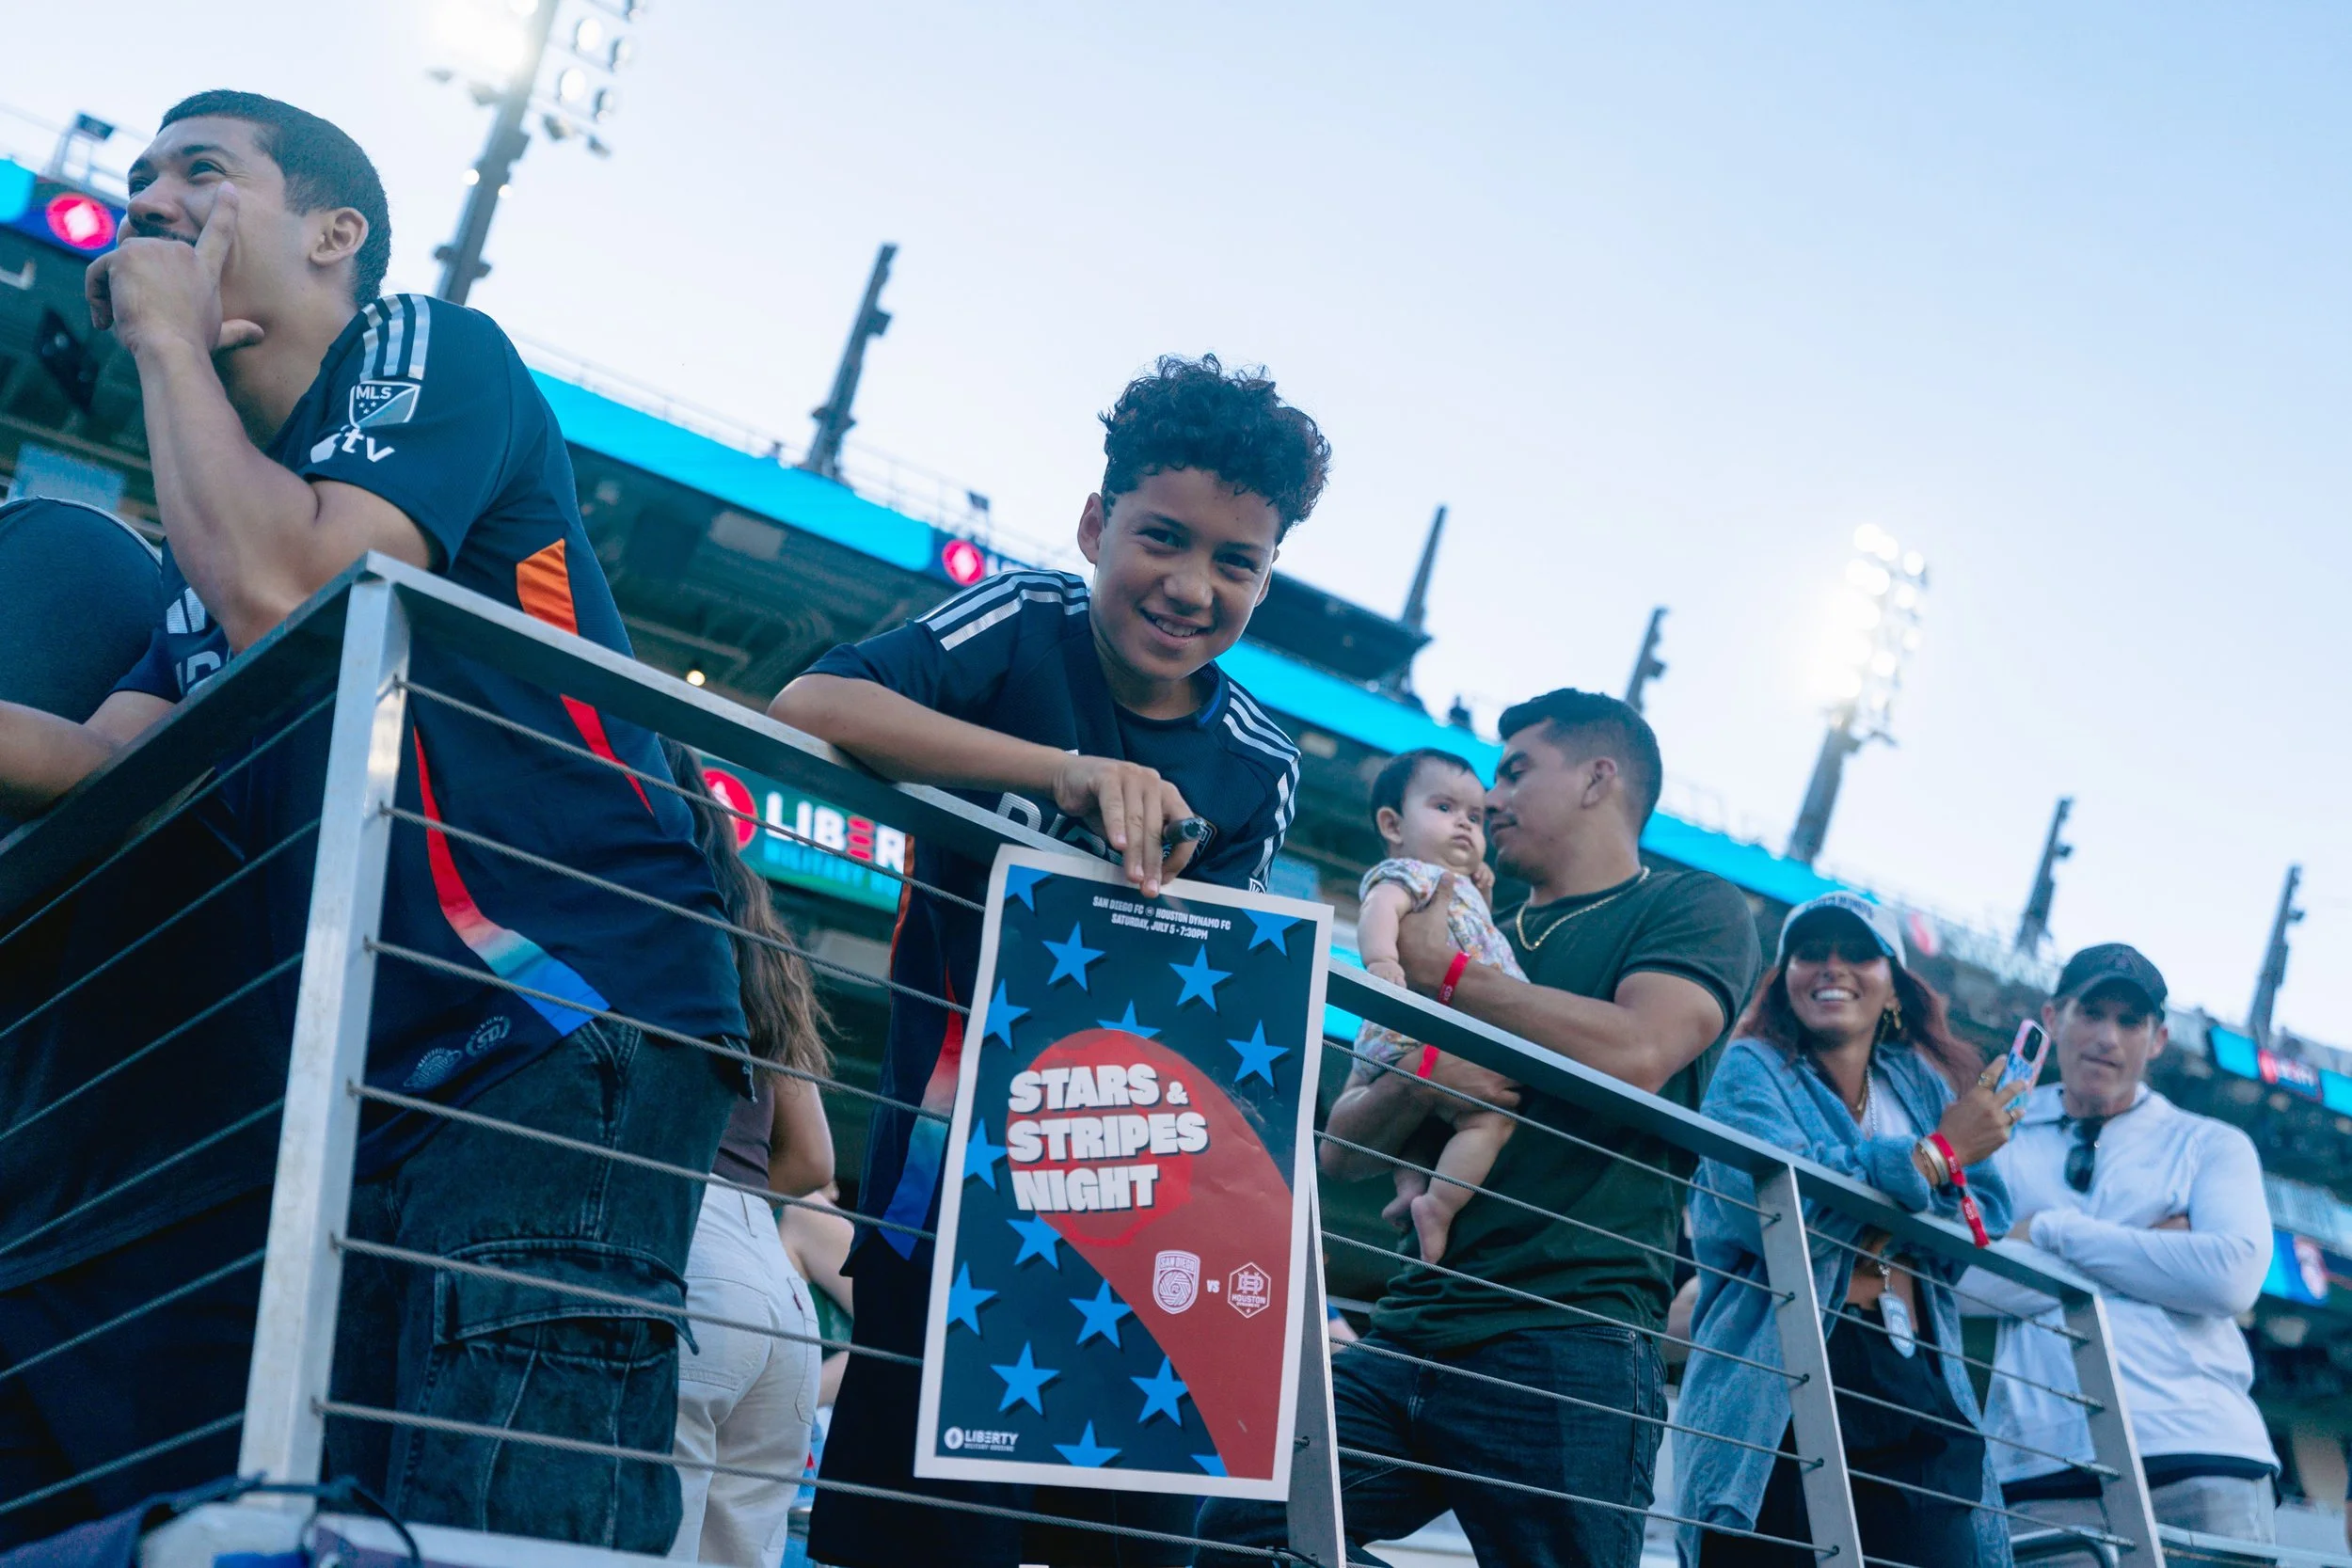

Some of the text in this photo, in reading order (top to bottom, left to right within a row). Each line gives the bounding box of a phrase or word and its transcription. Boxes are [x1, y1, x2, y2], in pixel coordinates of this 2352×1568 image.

[356, 385, 392, 399] MLS
[765, 791, 906, 875] LIBER
[1093, 896, 1108, 909] SAN
[1109, 900, 1132, 912] DIEGO
[1134, 904, 1144, 914] FC
[1155, 909, 1187, 923] HOUSTON
[1189, 914, 1219, 928] DYNAMO
[1221, 920, 1231, 930] FC
[1112, 914, 1208, 940] SATURDAY, JULY 5 7:30PM
[1008, 1063, 1189, 1113] STARS &
[1008, 1112, 1209, 1163] STRIPES
[1011, 1164, 1158, 1212] NIGHT
[1207, 1280, 1219, 1292] VS
[1232, 1293, 1266, 1305] HOUSTON
[965, 1430, 1018, 1445] LIBERTY
